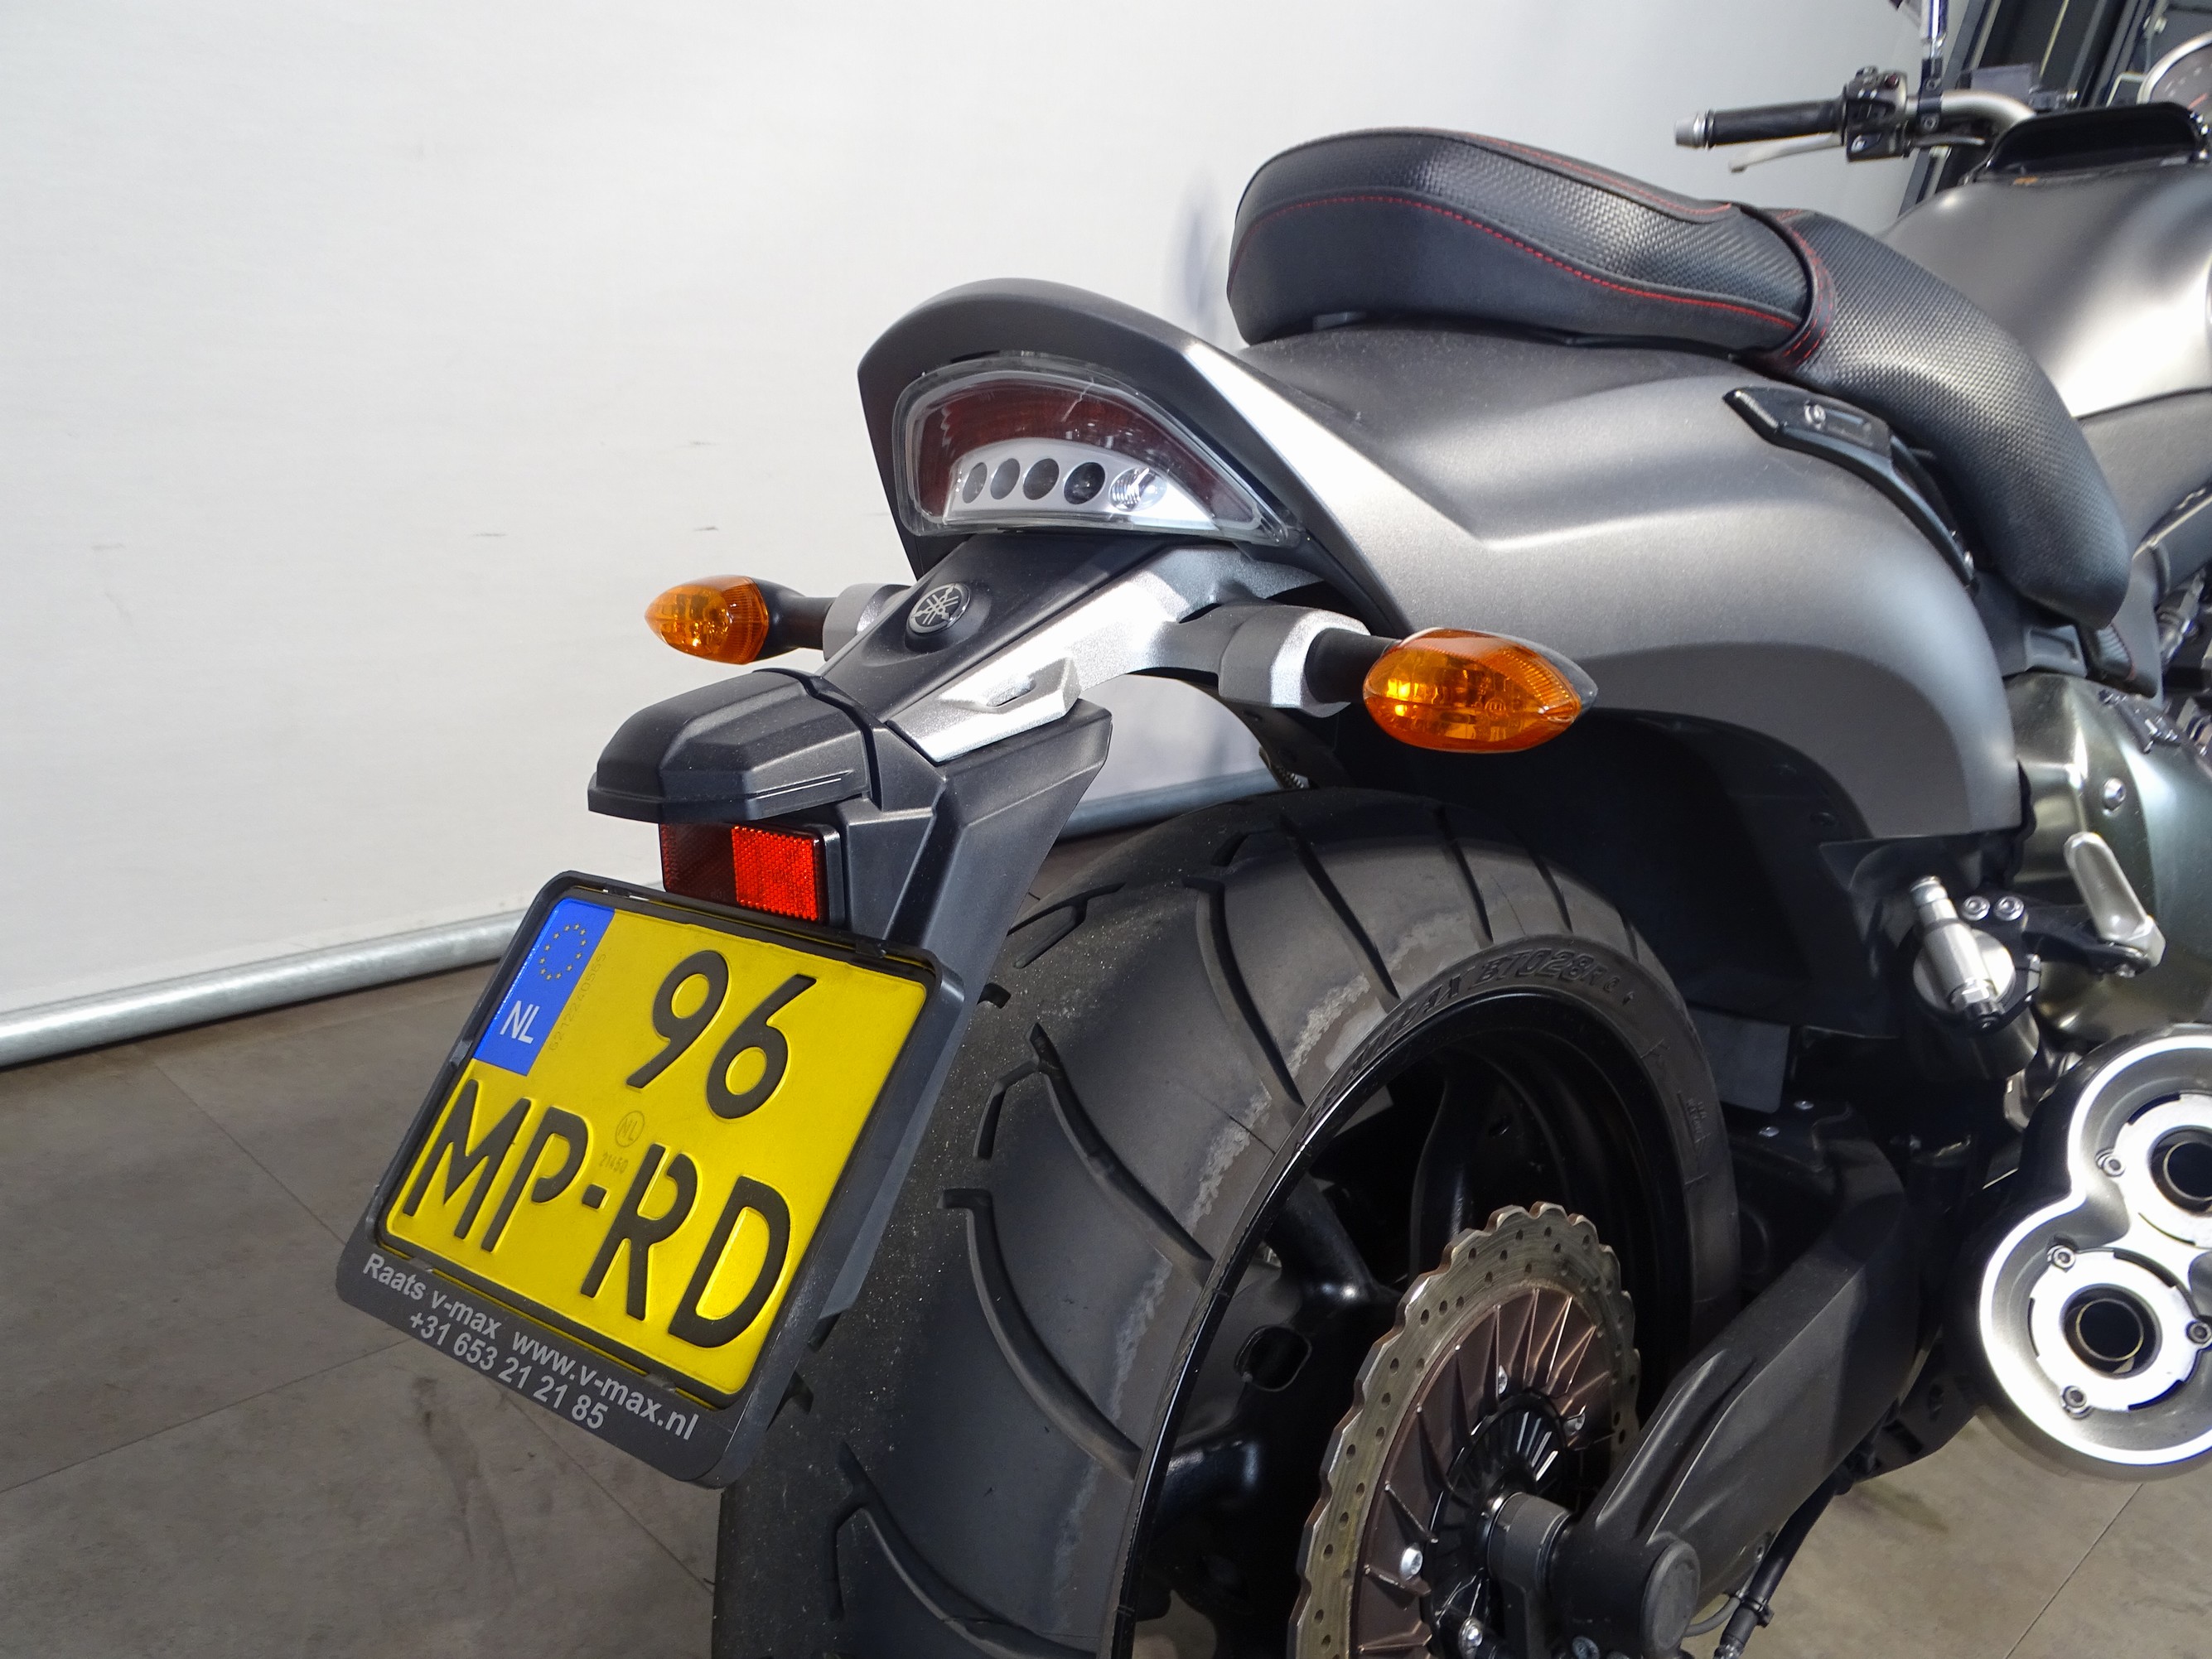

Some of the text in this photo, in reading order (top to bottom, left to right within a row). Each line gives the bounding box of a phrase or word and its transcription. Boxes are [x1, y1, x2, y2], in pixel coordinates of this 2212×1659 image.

[499, 1000, 540, 1044] NL
[625, 950, 817, 1120] 96
[402, 1078, 792, 1349] MP-RD
[362, 1252, 699, 1440] Raats v-max www.v-max.nl
[409, 1312, 609, 1430] +31 653 21 21 85
